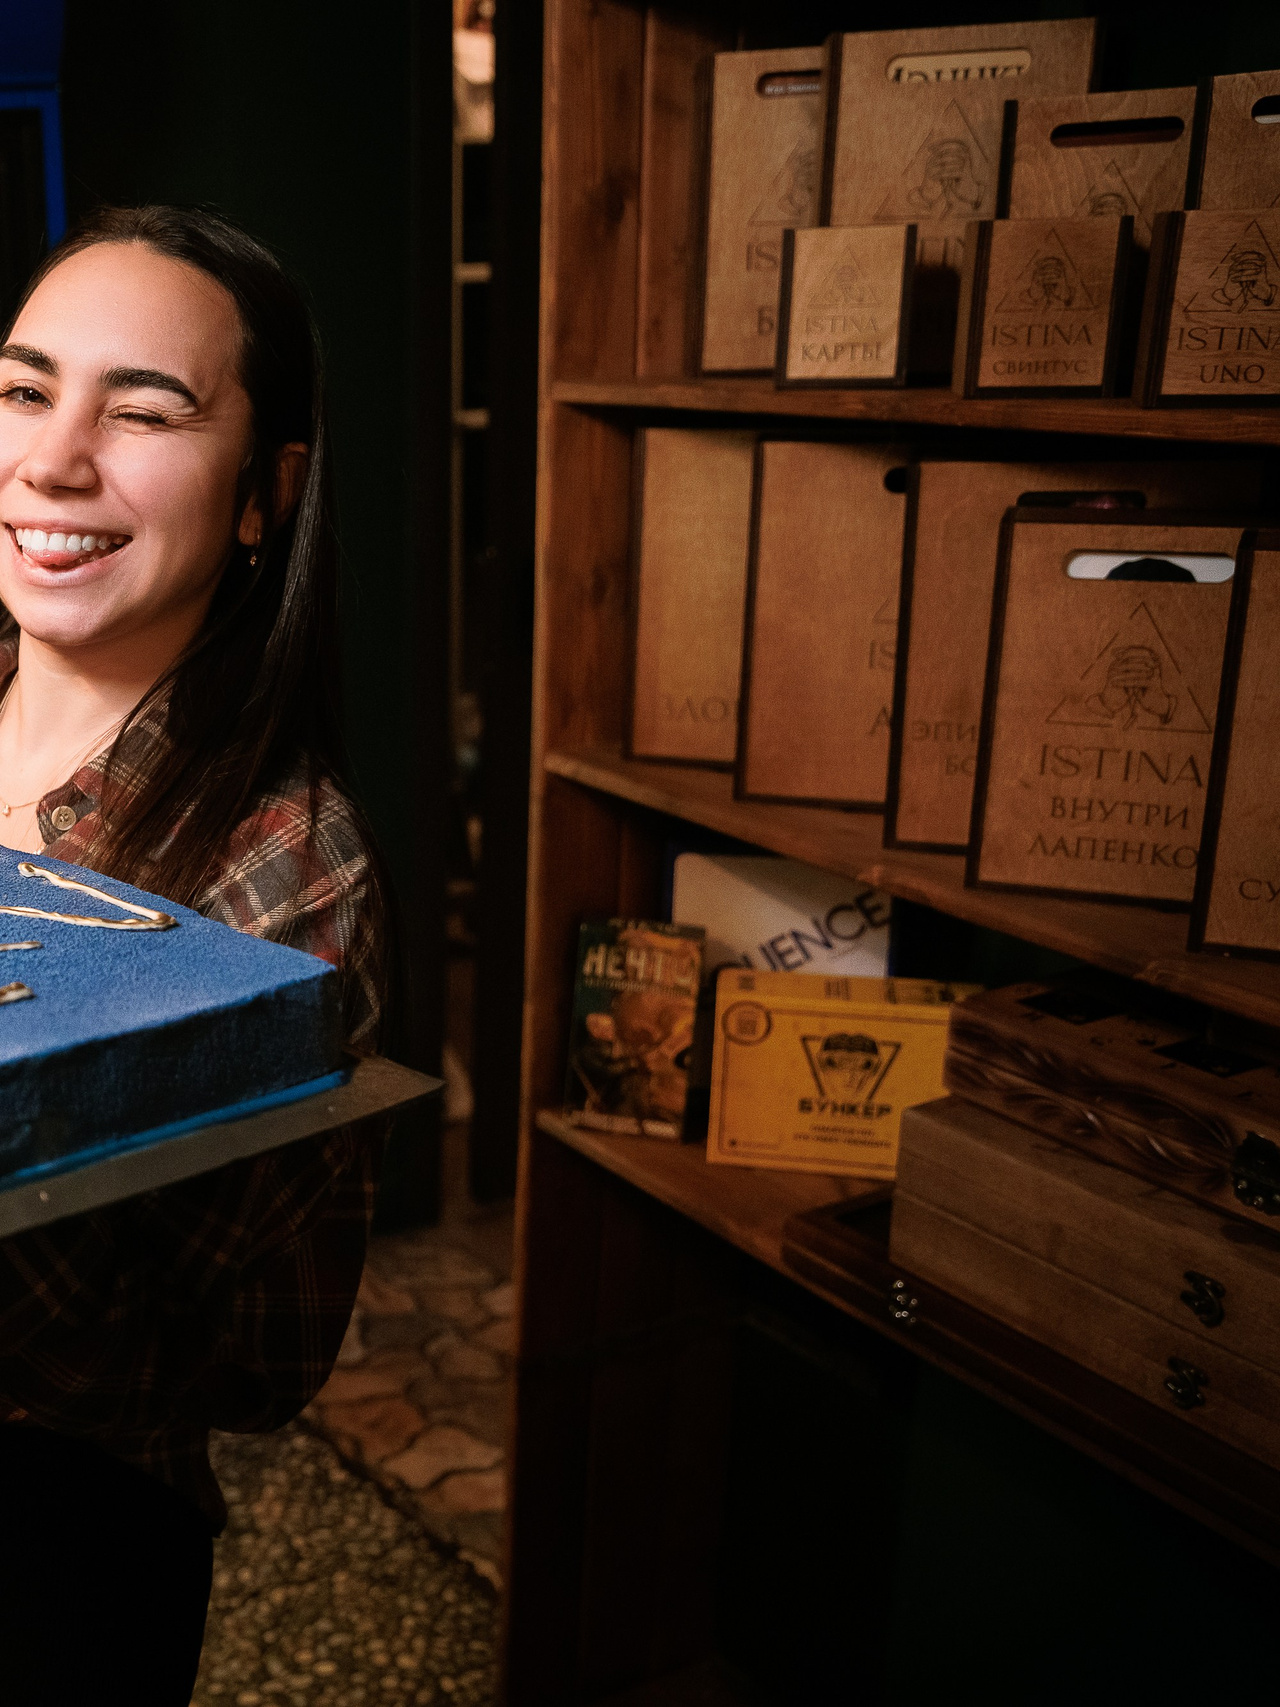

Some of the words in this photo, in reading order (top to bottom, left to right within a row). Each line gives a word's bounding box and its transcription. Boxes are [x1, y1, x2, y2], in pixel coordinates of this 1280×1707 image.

[805, 315, 879, 335] ISTINA
[991, 324, 1092, 347] ISTINA
[801, 341, 883, 362] КАРТЫ
[992, 359, 1089, 376] СВИНТУС
[1199, 364, 1265, 384] UNO
[1039, 743, 1203, 788] ISTINA
[1050, 796, 1189, 830] ВНУТРИ
[1028, 833, 1199, 870] ЛАПЕНКО
[797, 1097, 894, 1120] БУНКЕР
